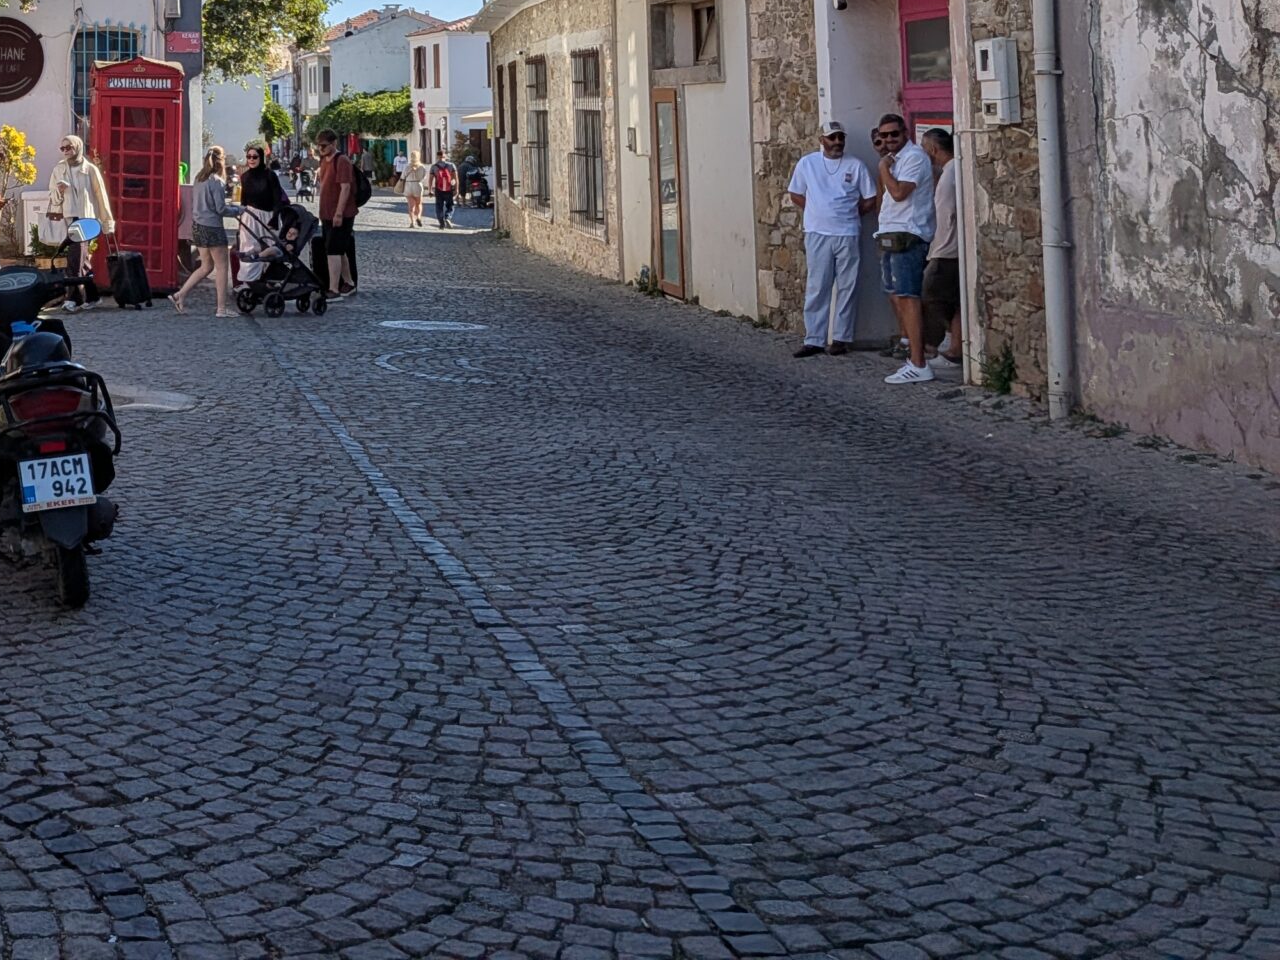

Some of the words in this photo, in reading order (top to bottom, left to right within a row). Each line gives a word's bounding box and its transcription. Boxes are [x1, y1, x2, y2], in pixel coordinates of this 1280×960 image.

[107, 77, 147, 89] POSTHANE
[151, 78, 171, 89] OTEL
[52, 477, 88, 498] 942
[47, 499, 75, 508] EKER
